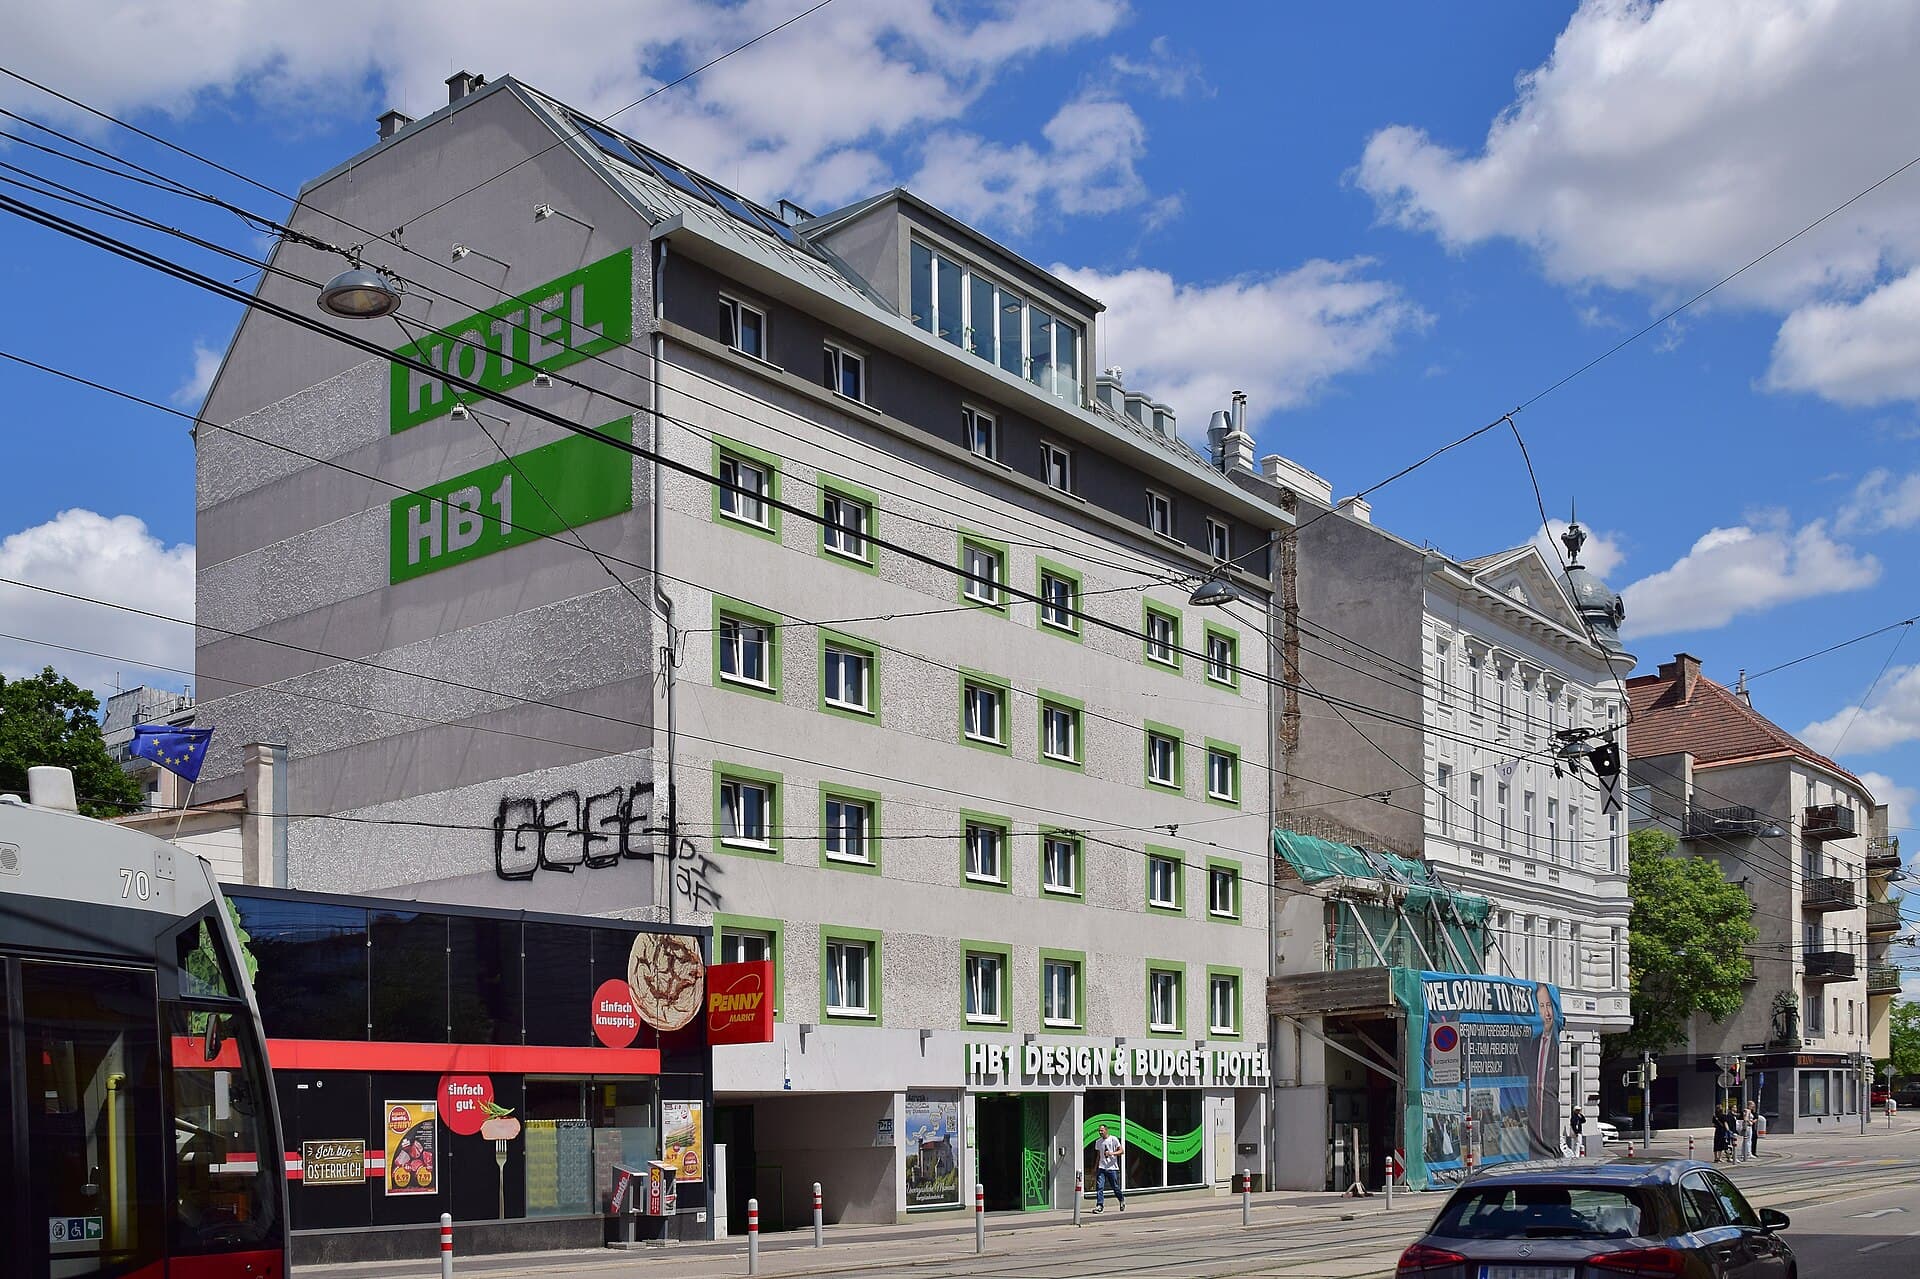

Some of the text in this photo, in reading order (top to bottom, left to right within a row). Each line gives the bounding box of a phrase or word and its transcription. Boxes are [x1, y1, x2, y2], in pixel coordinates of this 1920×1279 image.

[408, 284, 603, 414] HOTEL
[408, 474, 512, 566] HB1
[119, 867, 151, 901] 70
[709, 992, 764, 1013] PENNY
[1424, 980, 1535, 1014] WELCOME TO HB1
[600, 1001, 633, 1013] Einfach
[595, 1014, 637, 1028] knusprig.
[729, 1013, 756, 1023] MARKT
[966, 1043, 1271, 1078] HB1 DESIGN & BUDGET HOTEL
[447, 1084, 484, 1096] Einfach
[456, 1099, 476, 1112] gut.
[315, 1144, 353, 1159] Ich bin
[307, 1161, 361, 1179] ÖSTERREICH
[612, 1176, 629, 1208] Heute
